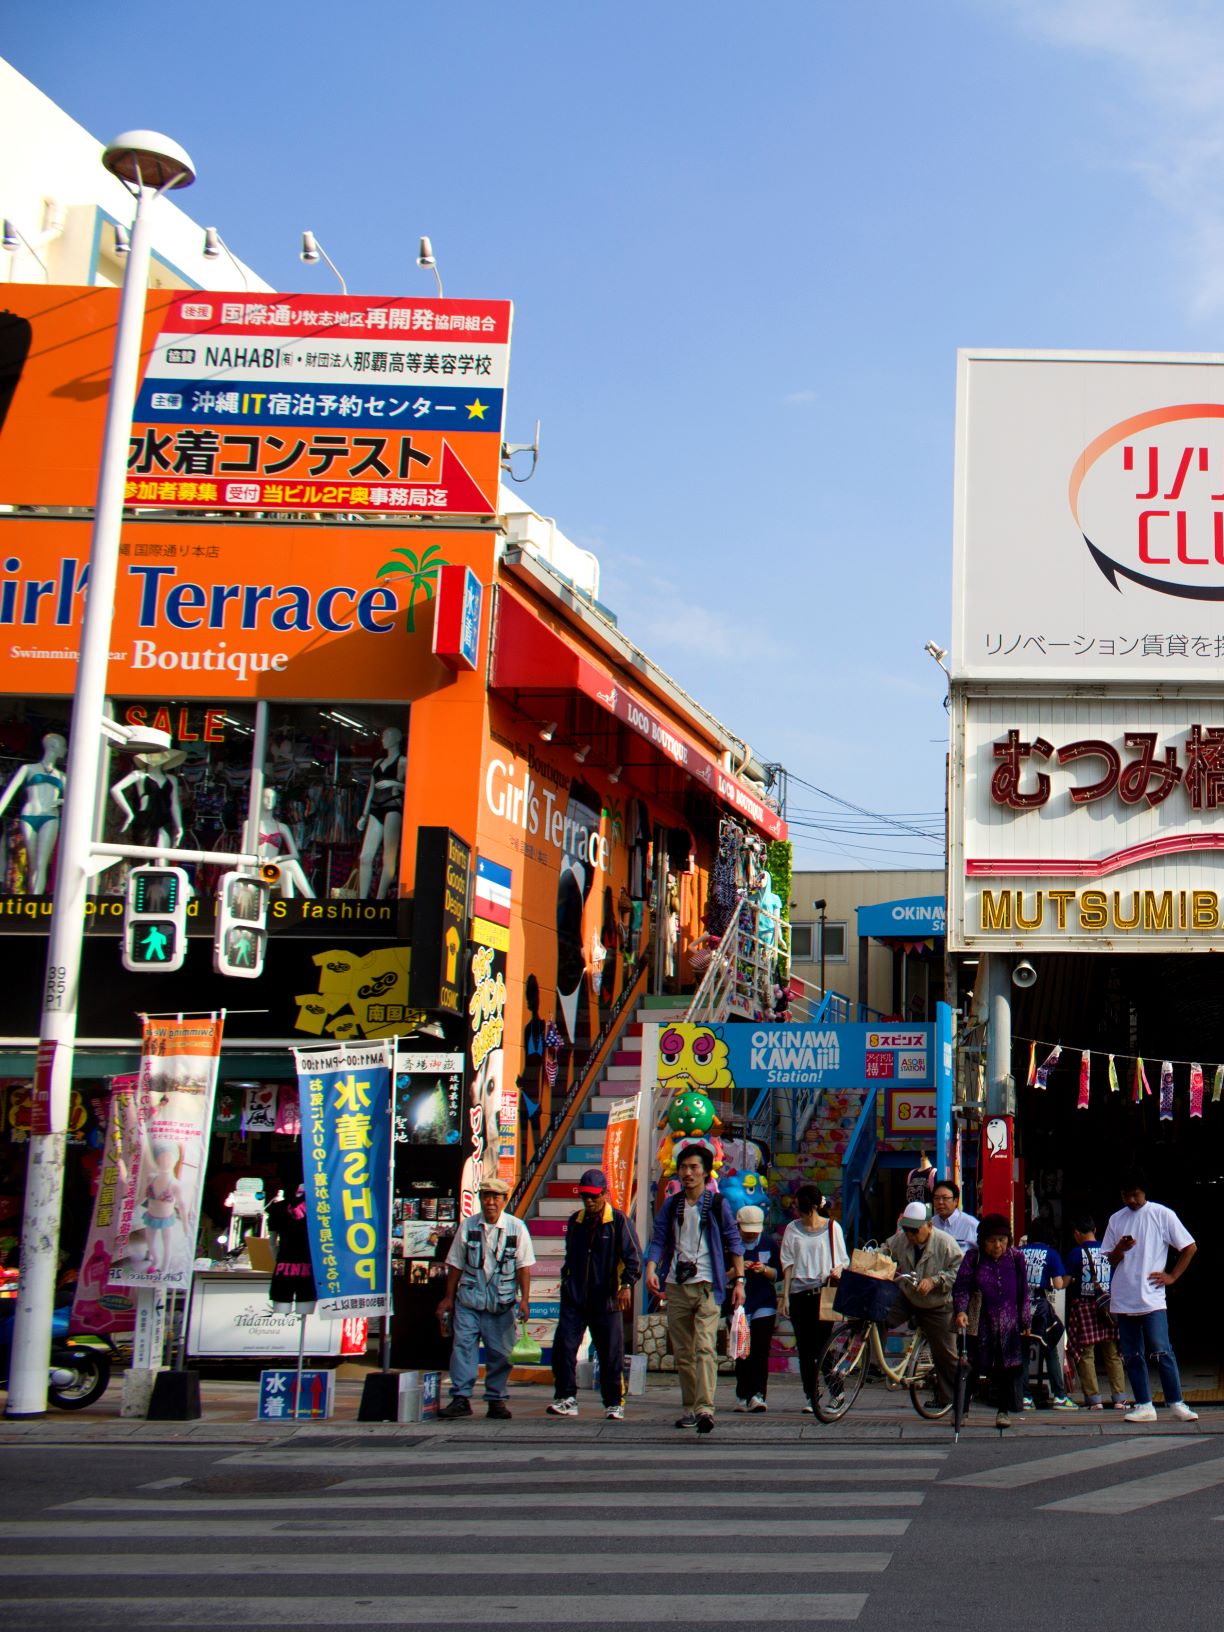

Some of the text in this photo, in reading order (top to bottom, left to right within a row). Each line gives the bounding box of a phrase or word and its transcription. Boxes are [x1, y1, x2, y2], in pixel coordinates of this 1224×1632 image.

[192, 392, 456, 418] 沖縄IT宿泊予約センター
[128, 430, 431, 479] 水着コンテスト
[129, 566, 397, 634] Terrace
[109, 651, 127, 661] ear
[131, 640, 288, 681] Boutique
[126, 706, 227, 742] SALE
[628, 703, 688, 764] LOCO BOUTIQUE
[486, 759, 609, 871] Girl's Terrace
[718, 776, 764, 822] LOCO BOUTIQUE
[302, 901, 391, 919] fashion
[767, 1070, 822, 1083] Station!
[275, 1263, 311, 1277] PINK
[265, 1373, 286, 1416] 水着
